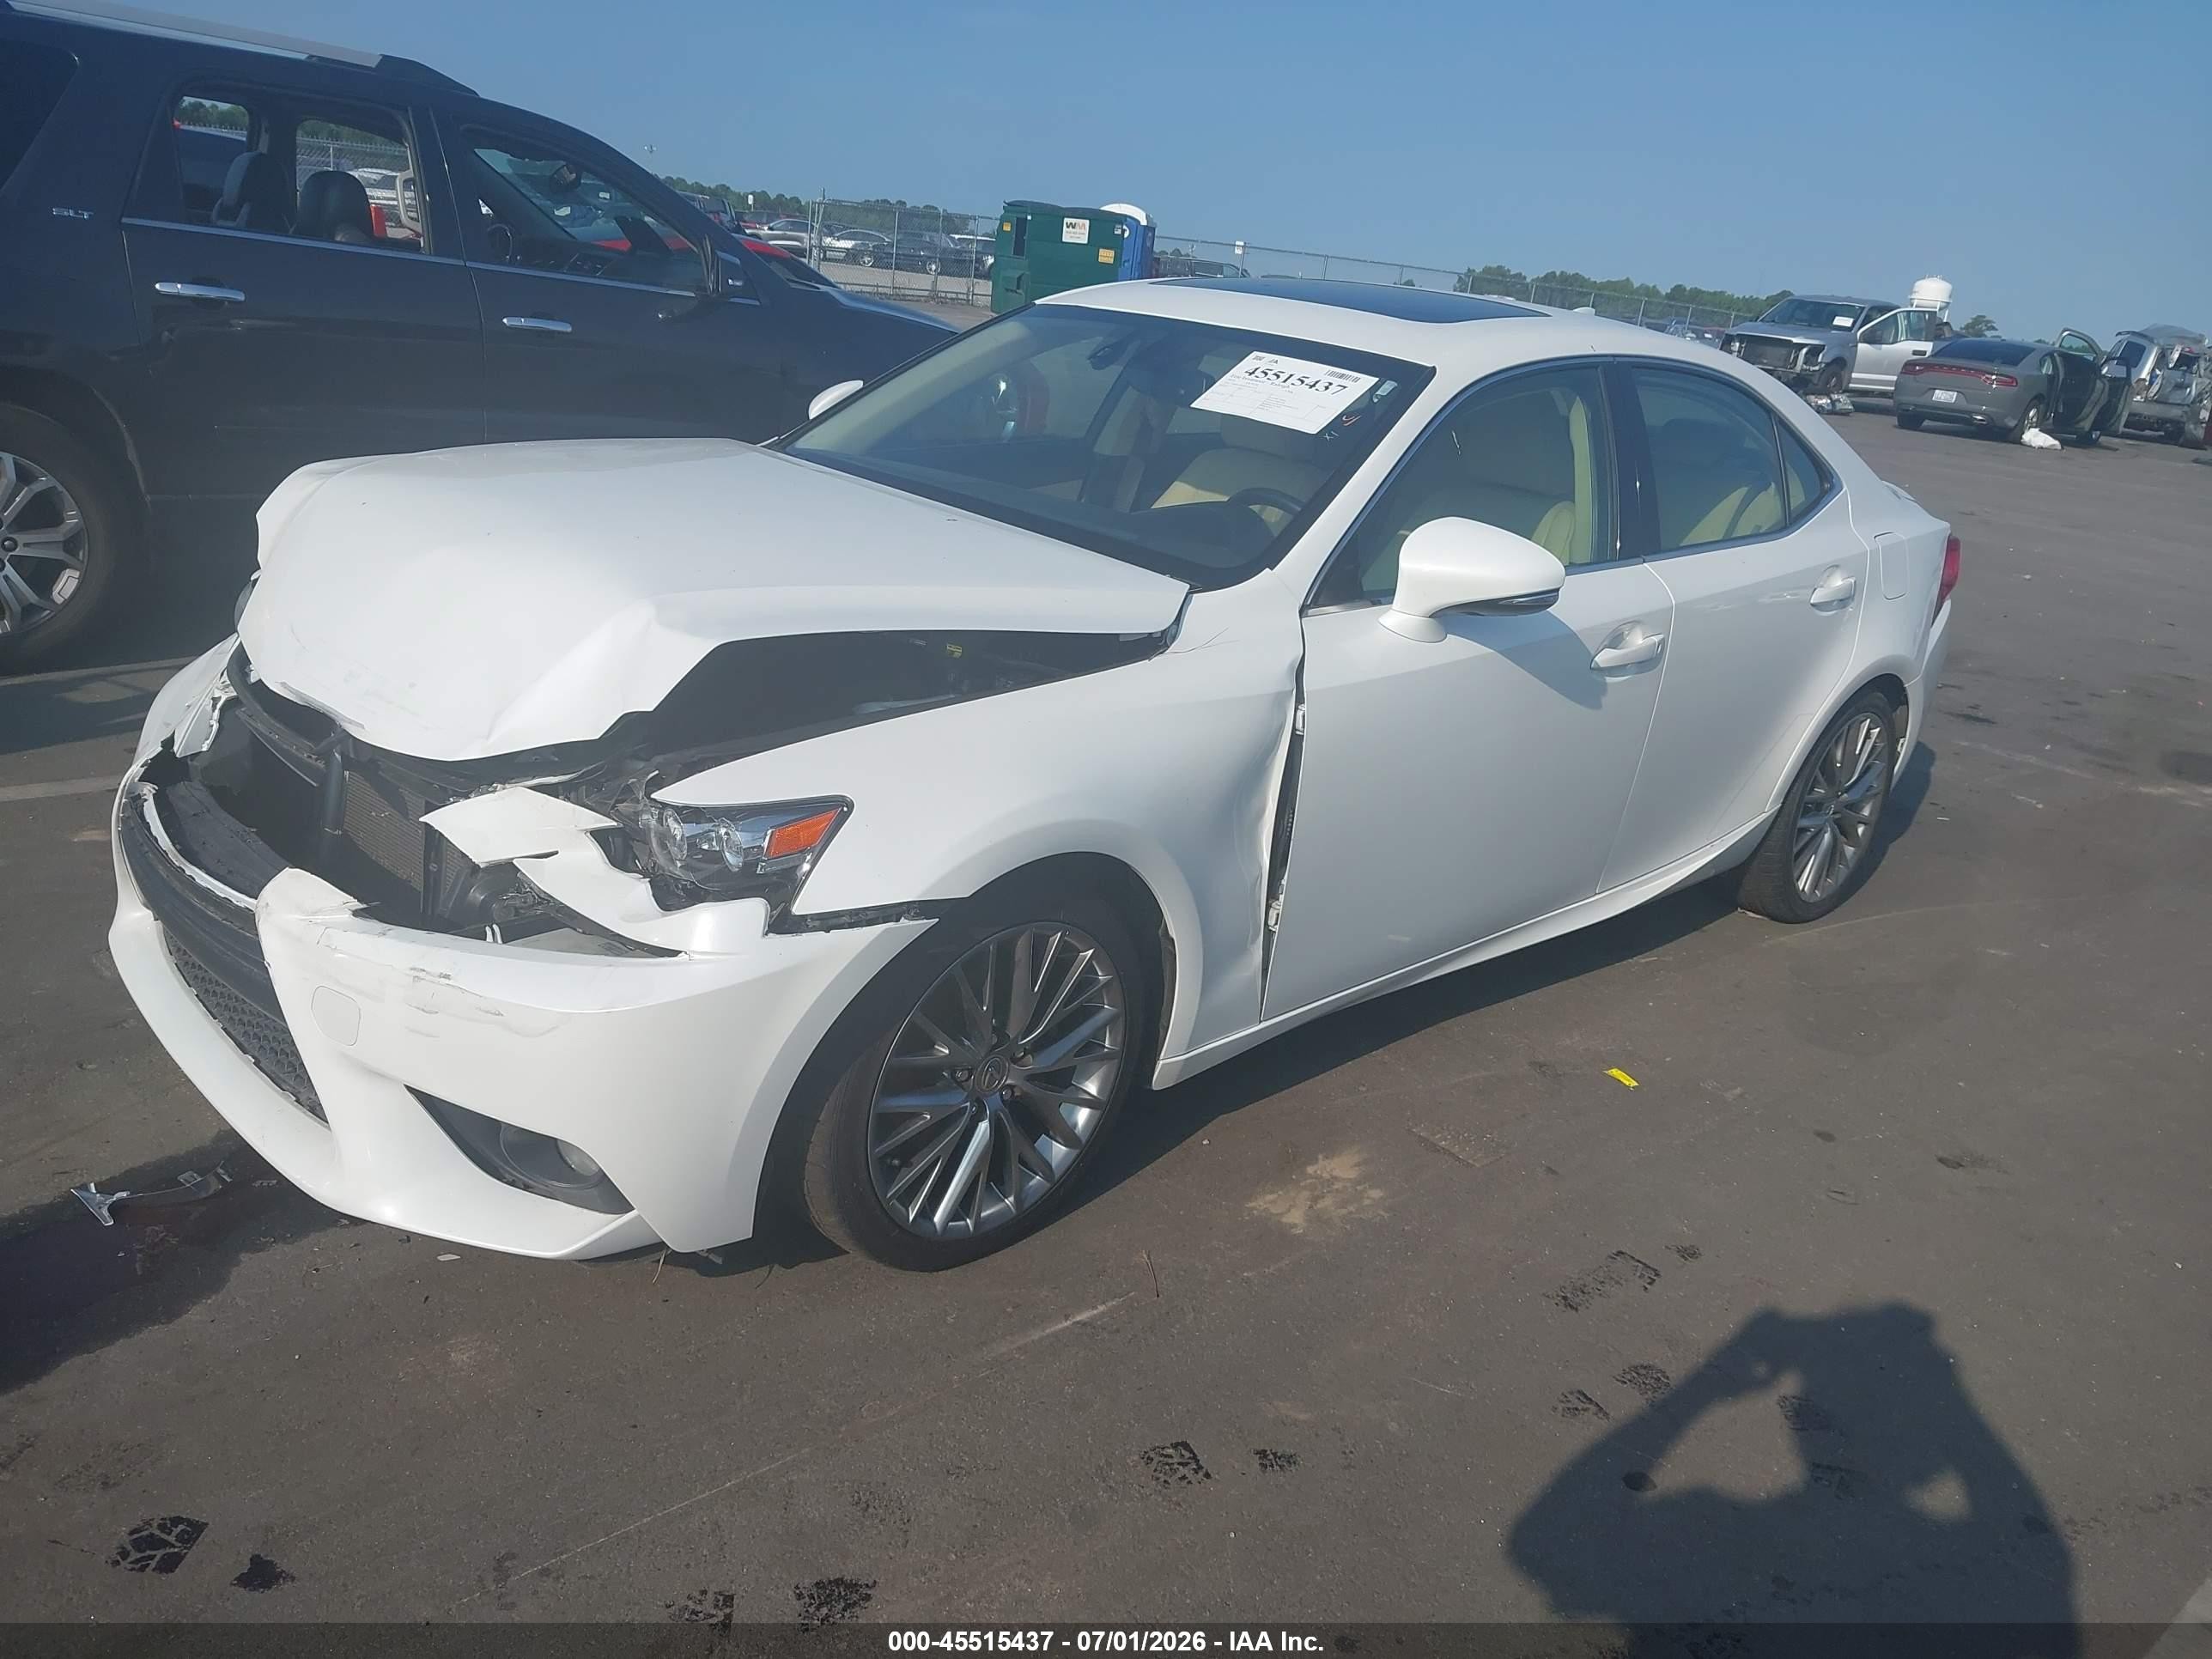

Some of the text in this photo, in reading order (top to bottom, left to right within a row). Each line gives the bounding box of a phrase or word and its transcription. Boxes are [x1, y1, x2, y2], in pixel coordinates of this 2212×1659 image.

[52, 208, 94, 219] SLT
[1065, 222, 1086, 230] WM
[1244, 367, 1348, 395] 45515437
